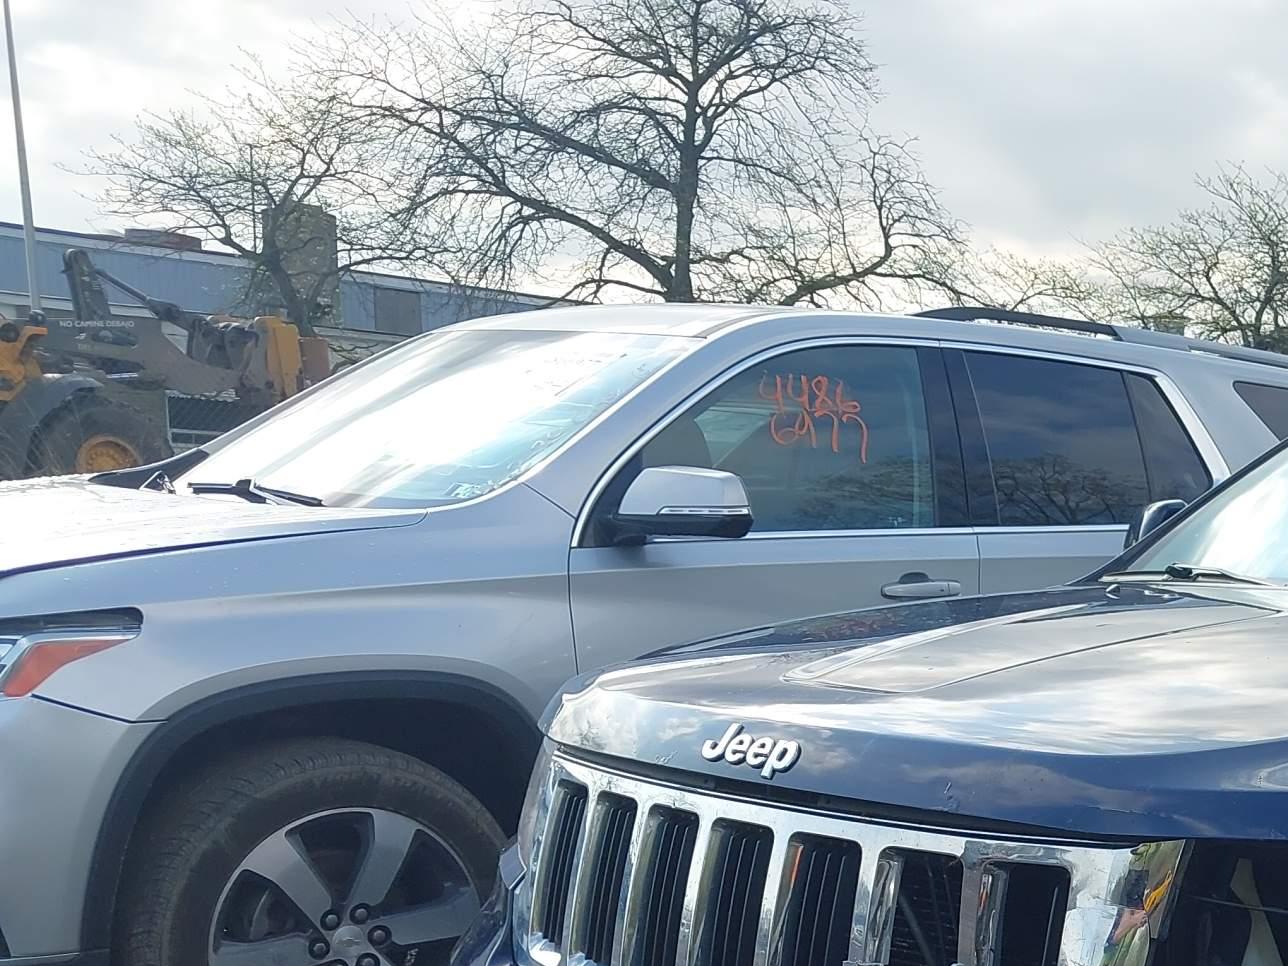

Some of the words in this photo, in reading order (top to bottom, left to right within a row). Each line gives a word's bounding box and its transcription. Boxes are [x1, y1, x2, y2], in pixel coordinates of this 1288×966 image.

[59, 320, 73, 328] NO
[105, 320, 135, 329] DEBAJO
[701, 722, 802, 780] Jeep
